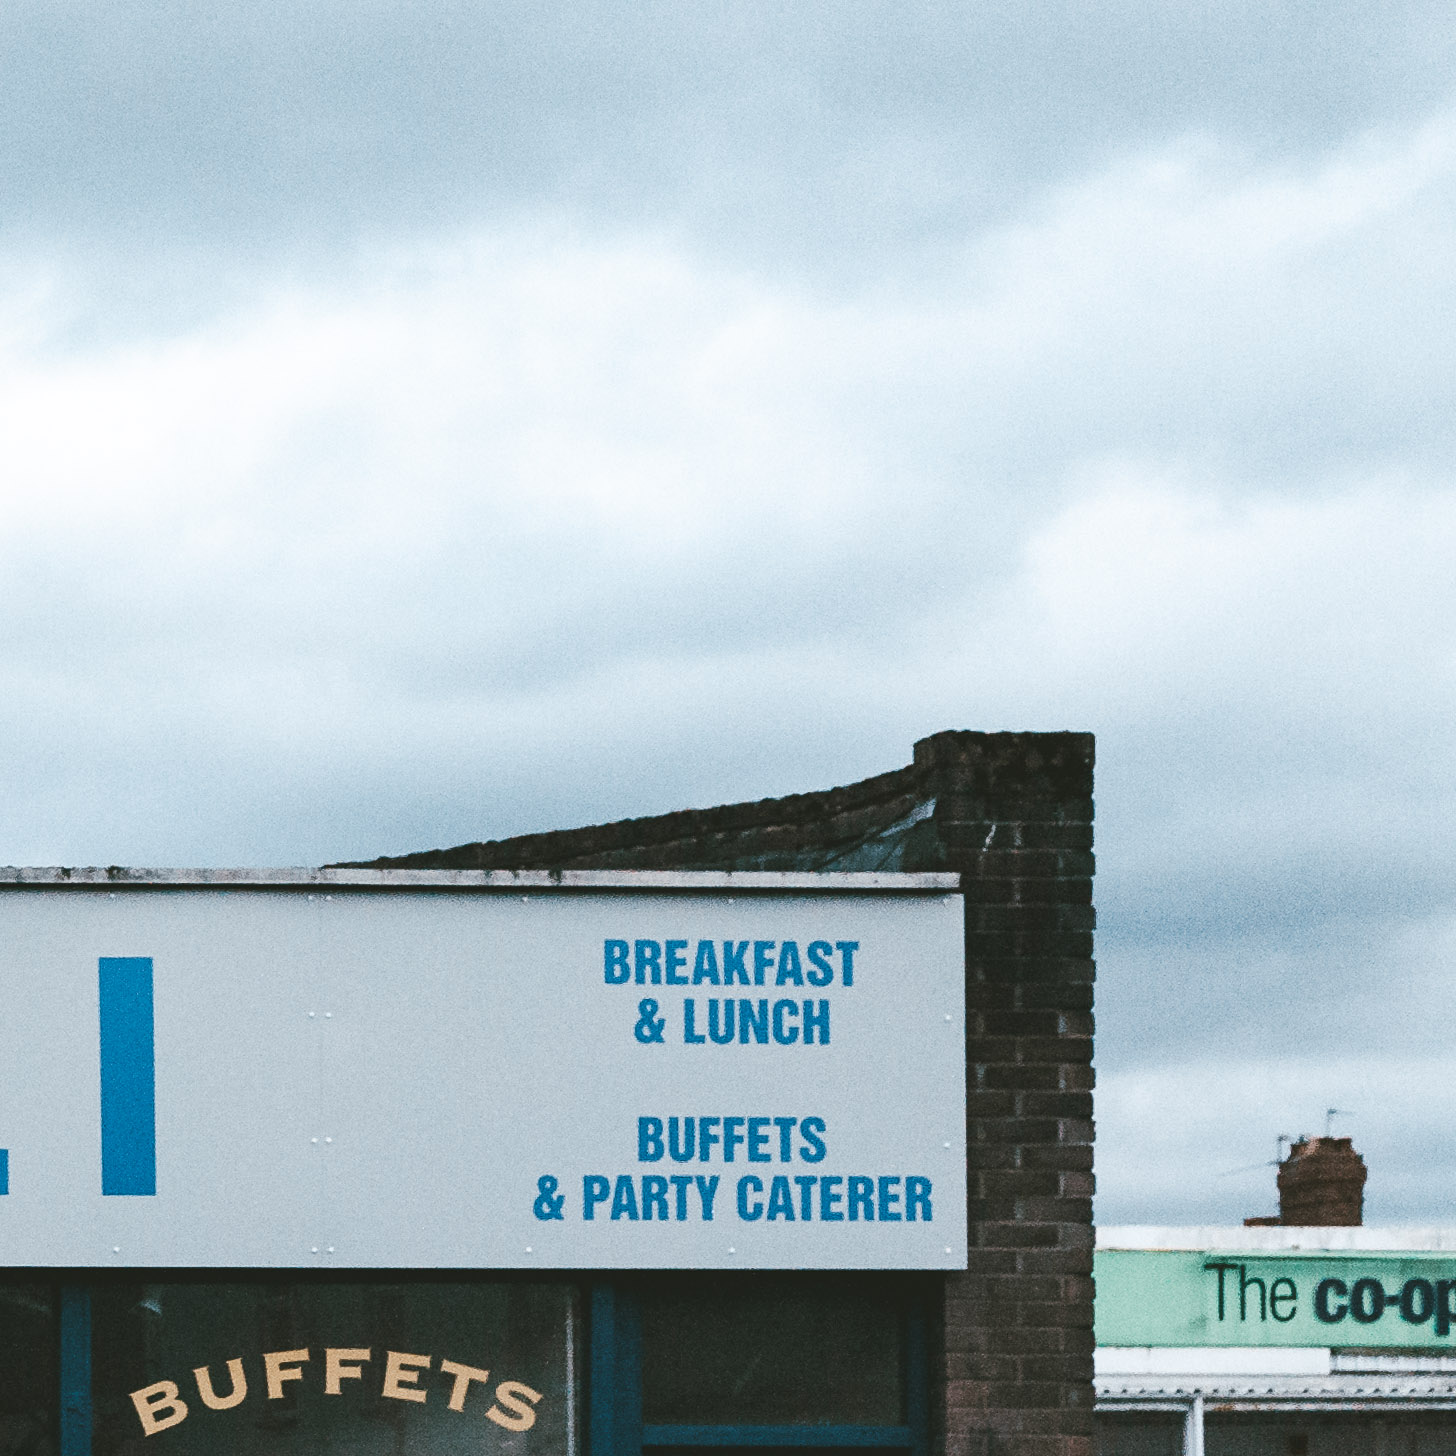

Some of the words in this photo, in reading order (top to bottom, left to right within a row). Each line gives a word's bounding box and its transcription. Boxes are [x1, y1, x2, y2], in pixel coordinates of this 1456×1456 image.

[603, 939, 860, 987] BREAKFAST
[634, 998, 666, 1044] &
[683, 998, 831, 1046] LUNCH
[637, 1116, 827, 1163] BUFFETS
[532, 1174, 565, 1221] &
[582, 1174, 721, 1222] PARTY
[736, 1175, 933, 1222] CATERER
[1203, 1263, 1298, 1322] The
[1314, 1277, 1456, 1337] co-op
[128, 1347, 544, 1437] BUFFETS
